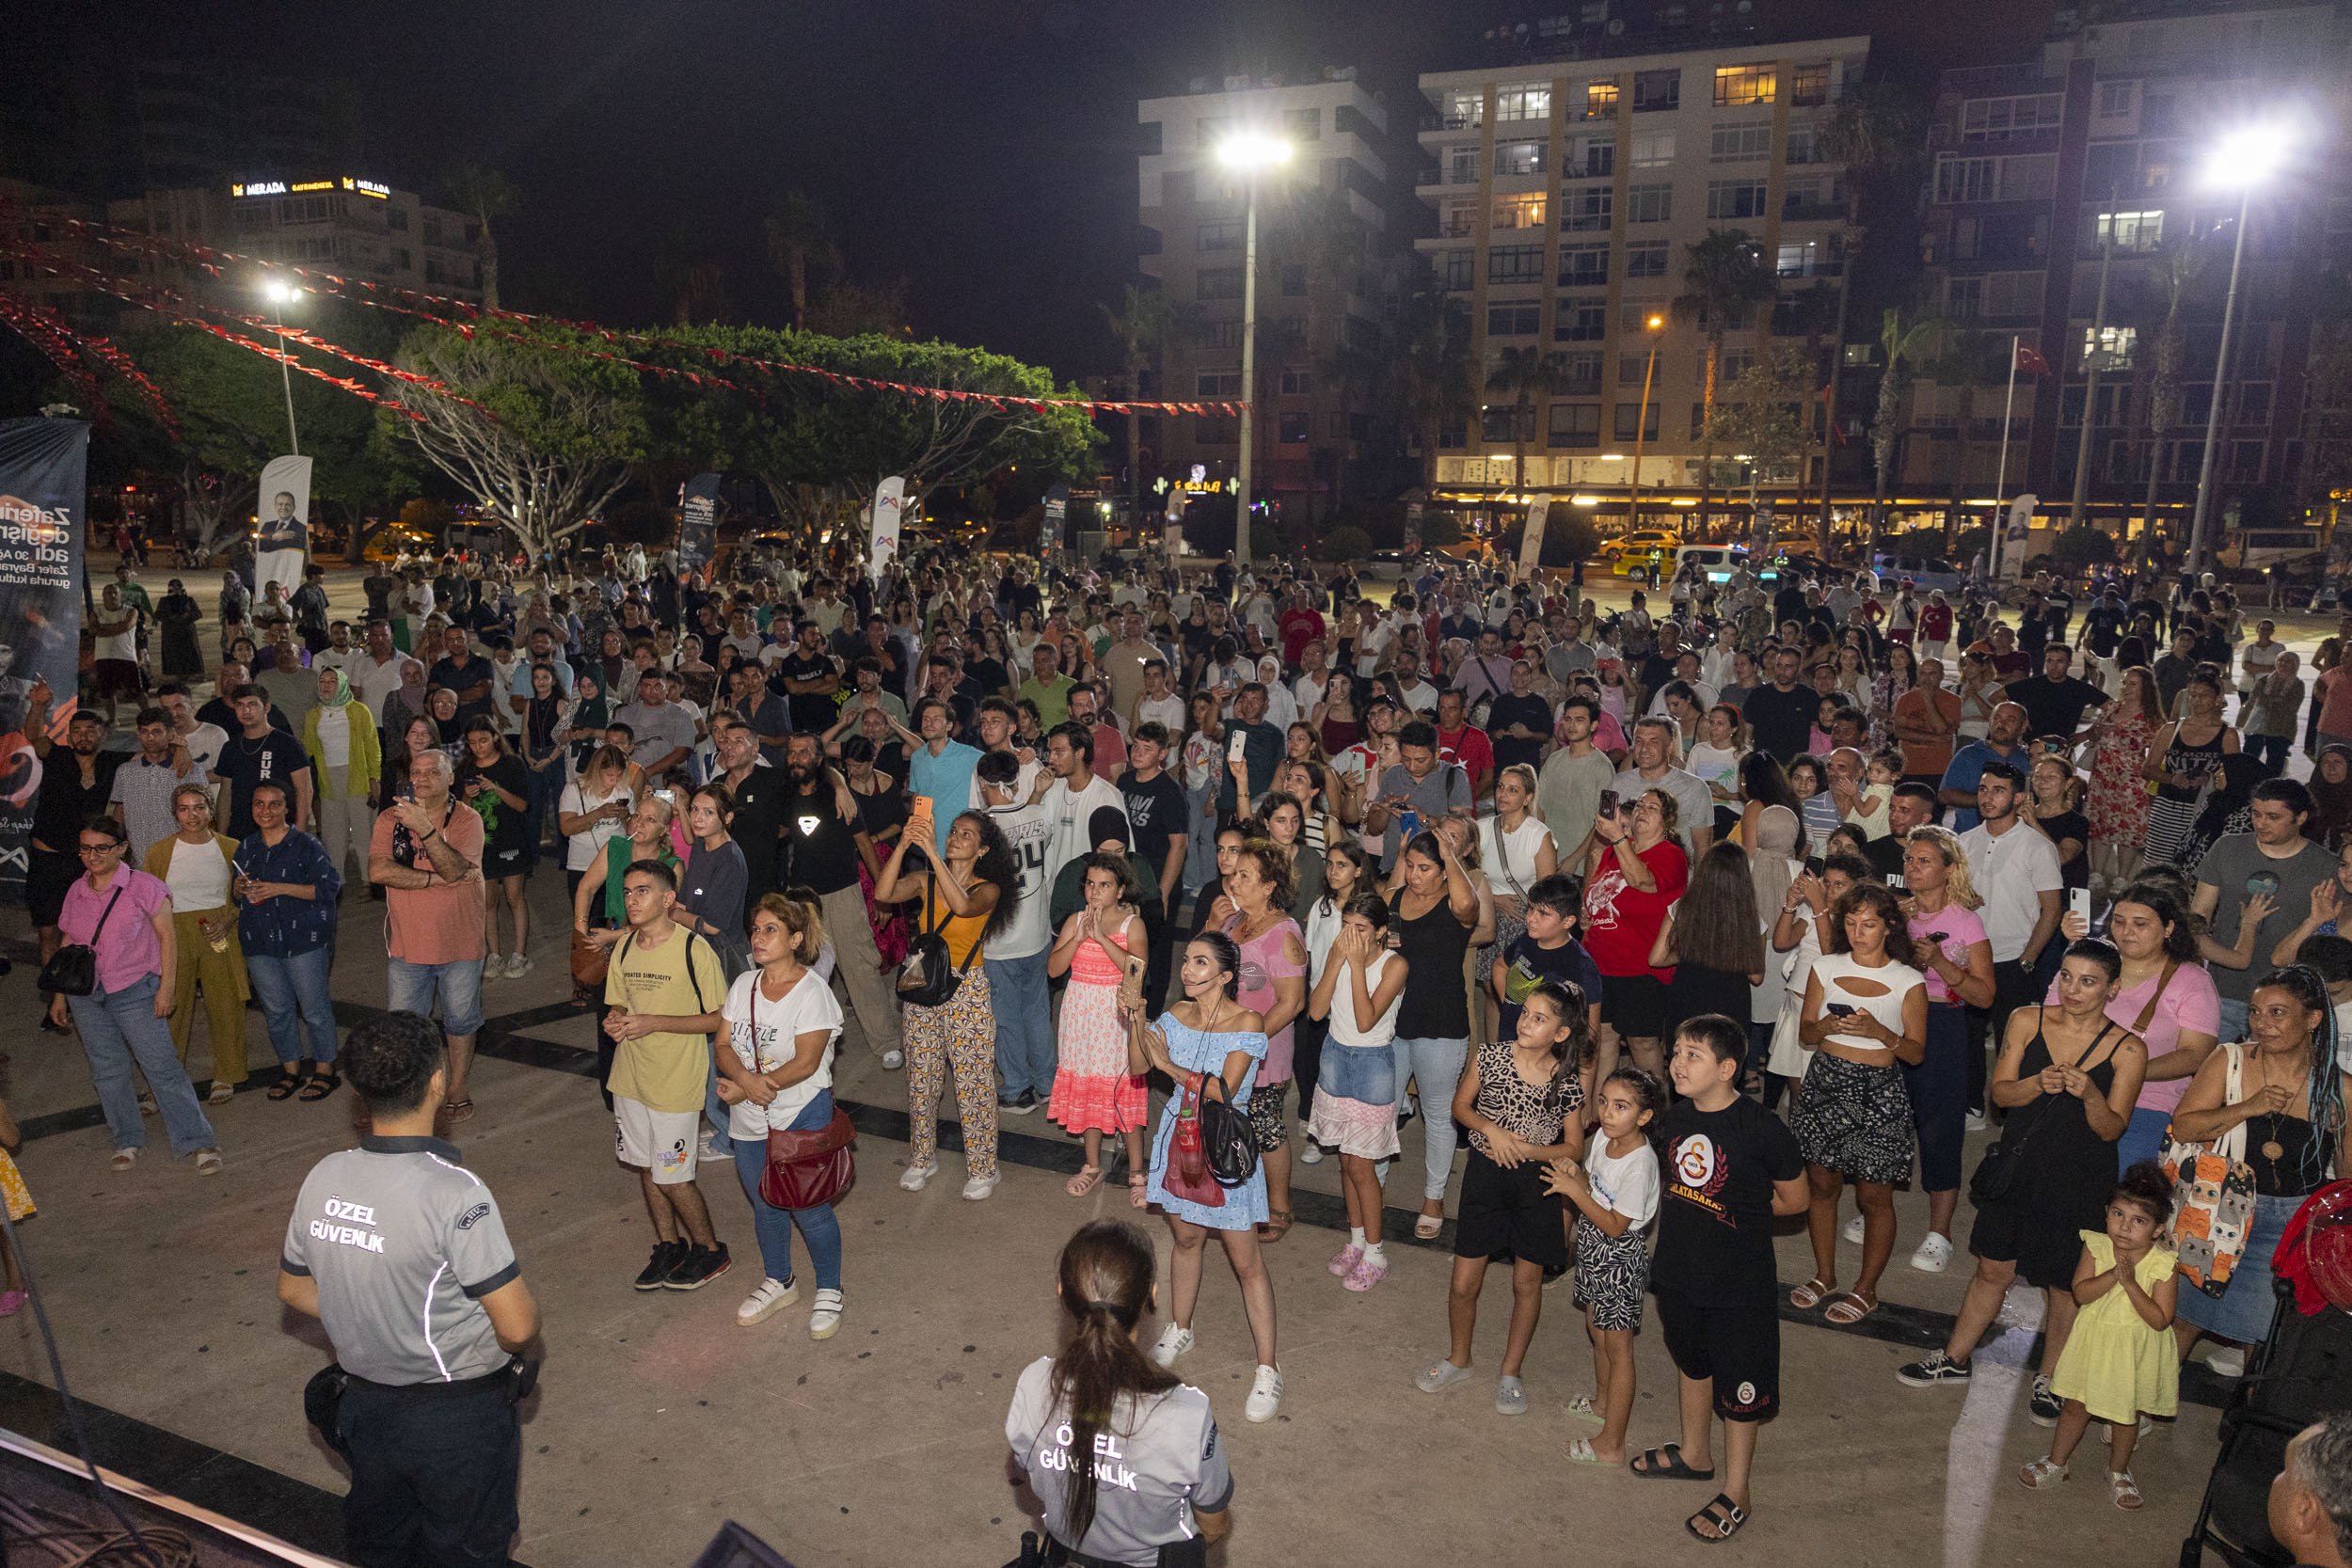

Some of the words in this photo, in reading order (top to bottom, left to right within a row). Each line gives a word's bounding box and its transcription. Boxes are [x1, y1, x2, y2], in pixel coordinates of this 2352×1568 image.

[246, 182, 286, 196] MERADA
[357, 179, 390, 195] MERADA
[260, 751, 273, 781] BUR
[643, 973, 672, 982] SIMPLICITY
[325, 1195, 377, 1227] ÖZEL
[310, 1218, 386, 1255] GÜVENLİK
[1056, 1420, 1122, 1461] ÖEL
[1040, 1447, 1137, 1492] GÜVNLİK
